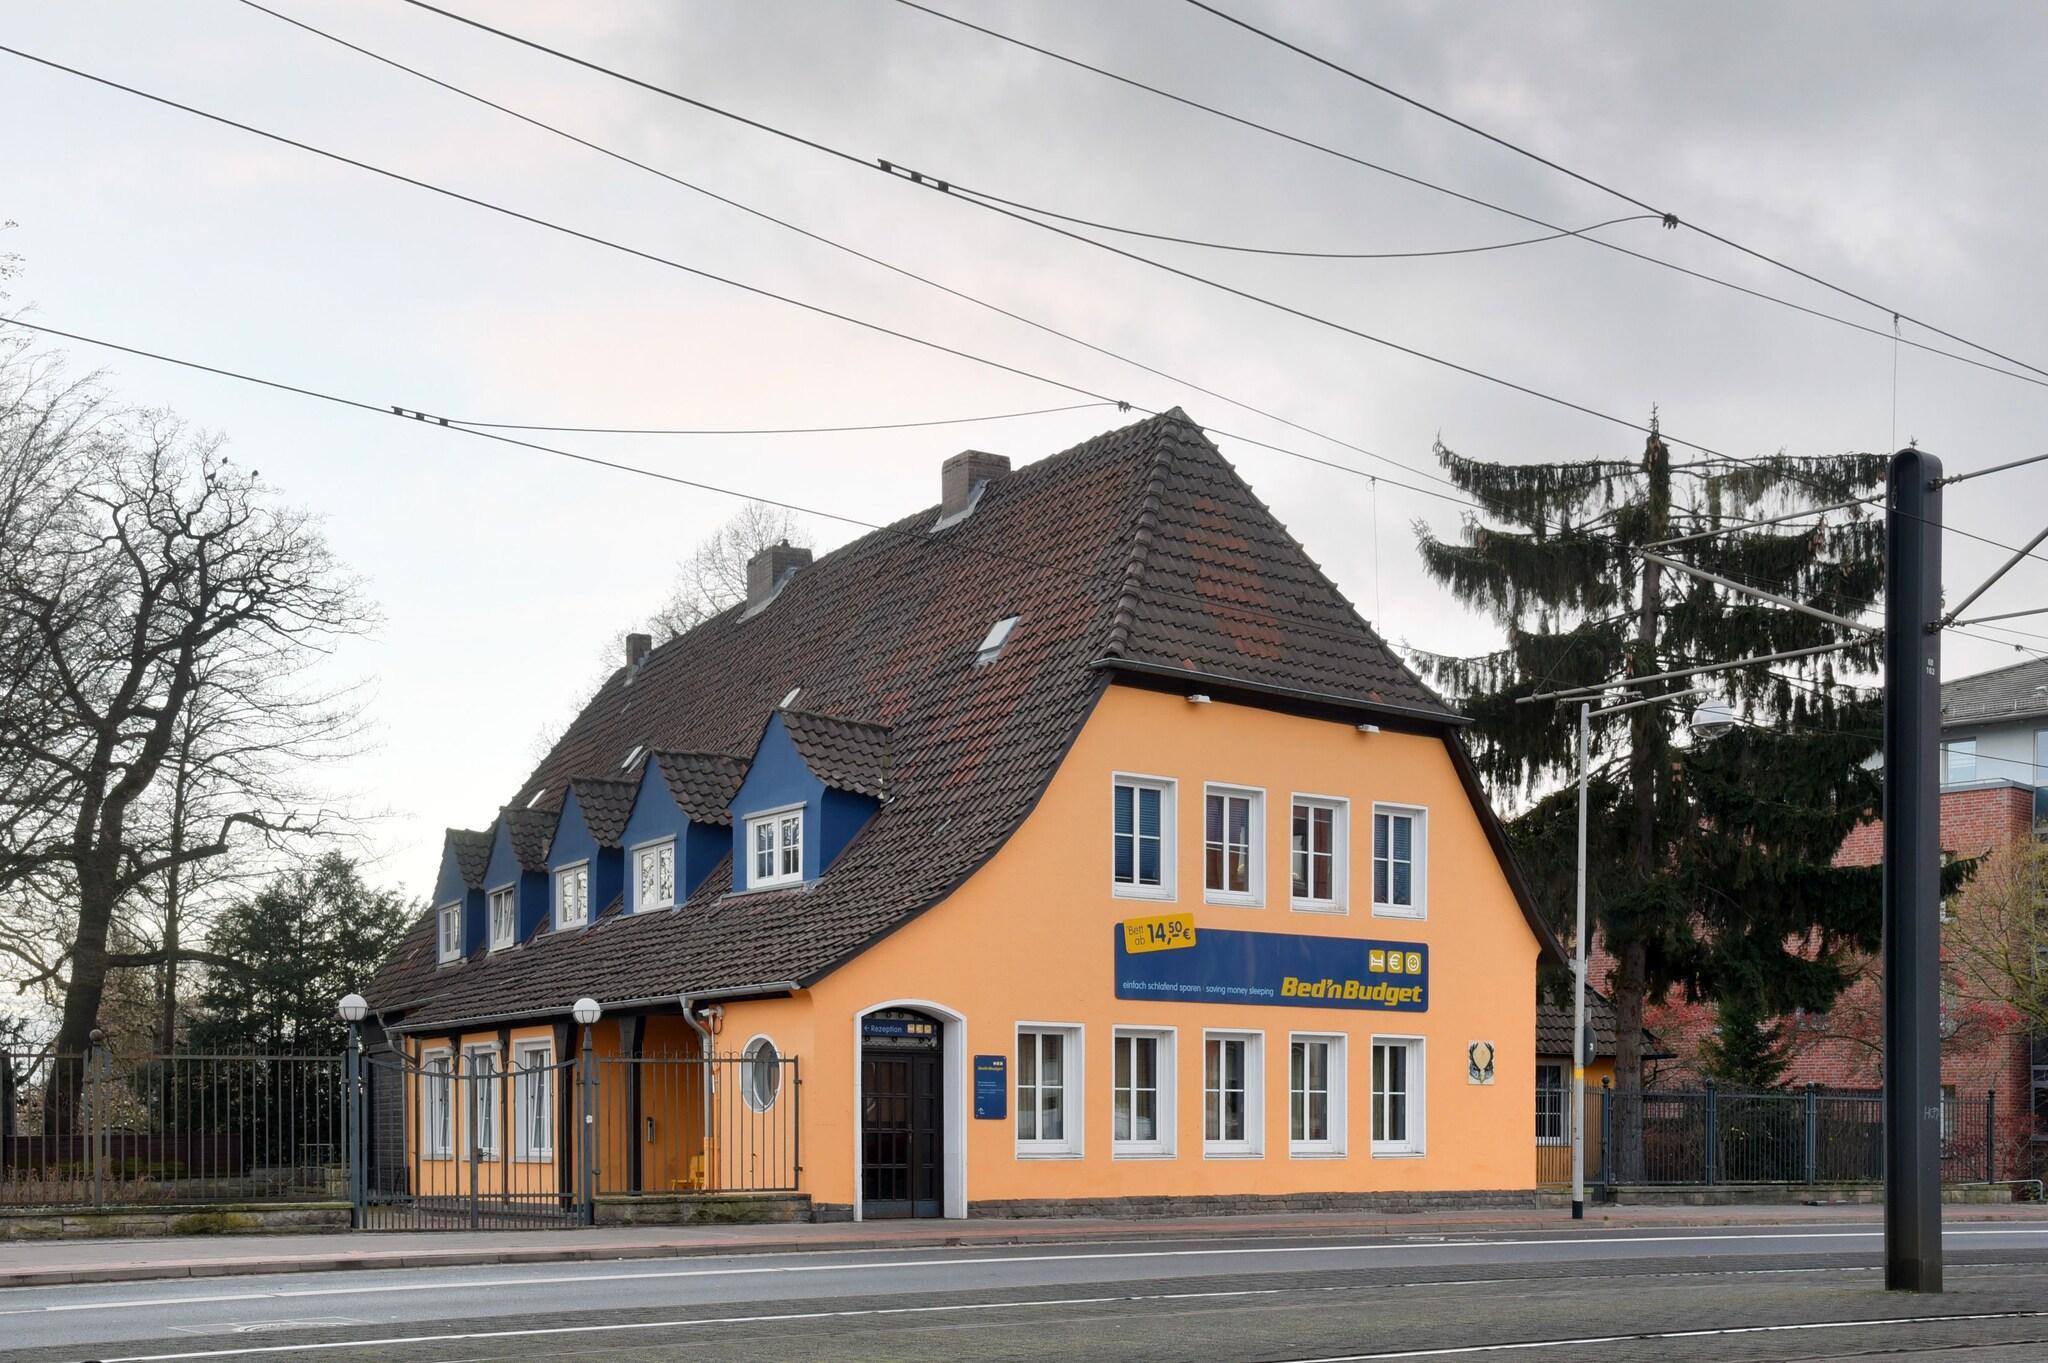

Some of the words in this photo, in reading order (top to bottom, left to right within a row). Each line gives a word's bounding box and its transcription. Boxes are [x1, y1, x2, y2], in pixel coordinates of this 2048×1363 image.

[1127, 924, 1144, 935] Bett
[1135, 934, 1146, 945] ab
[1122, 980, 1146, 989] einfach
[1148, 981, 1178, 991] schlafend
[1179, 984, 1202, 993] sparen
[1206, 985, 1226, 995] saving
[1226, 986, 1248, 996] money
[1249, 986, 1274, 997] sleeping
[870, 1024, 903, 1034] Rezeption
